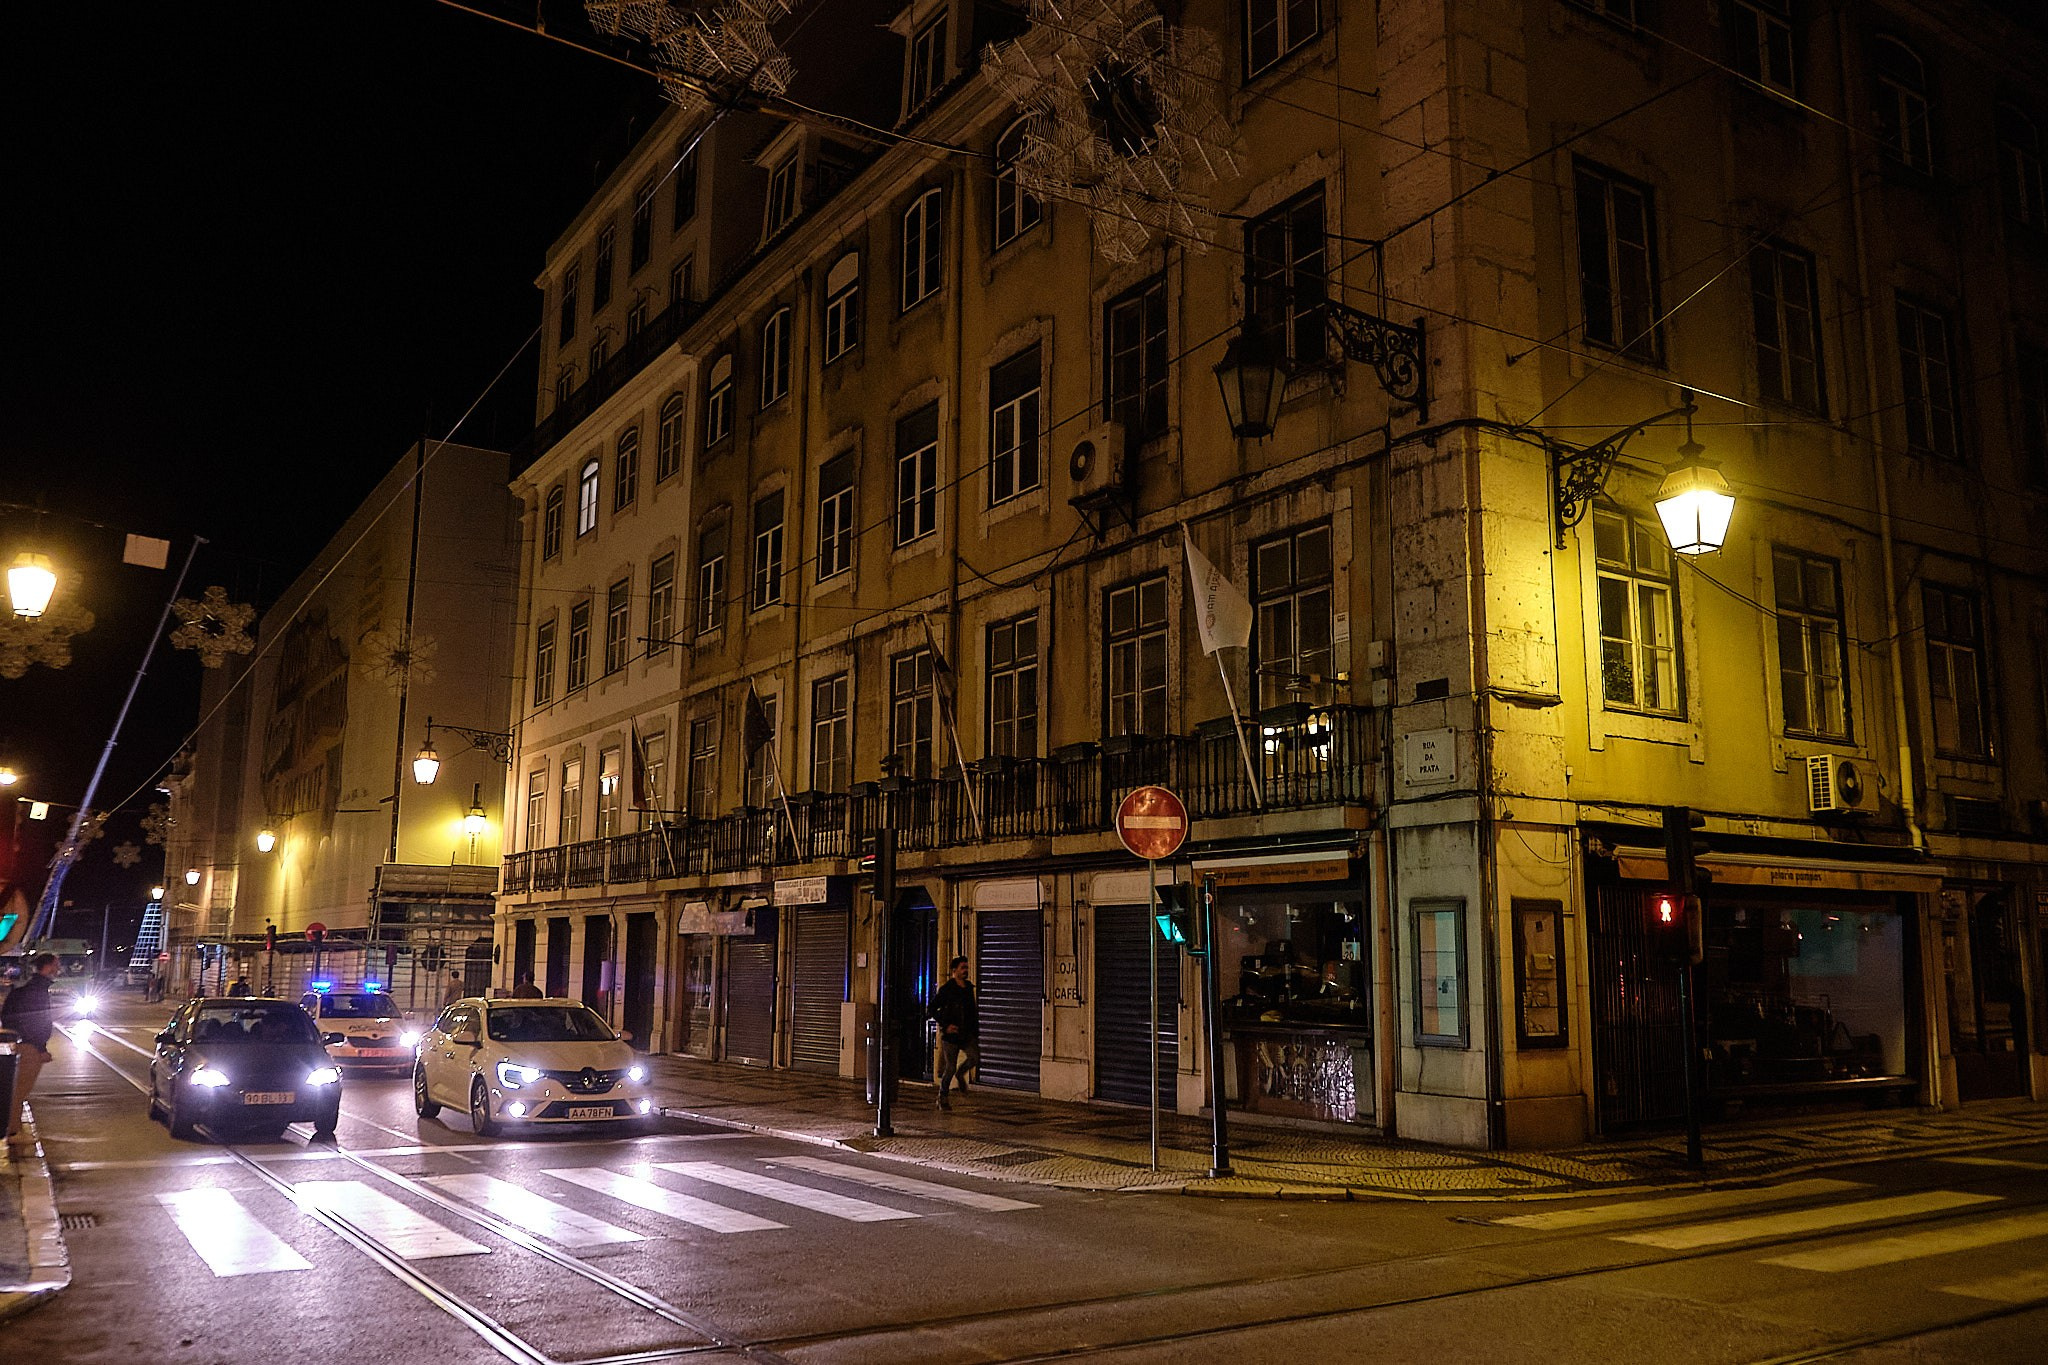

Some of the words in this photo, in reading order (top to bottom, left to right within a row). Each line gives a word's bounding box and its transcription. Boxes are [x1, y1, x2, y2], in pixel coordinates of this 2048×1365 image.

[1422, 741, 1436, 750] RUA
[1424, 753, 1434, 761] DA
[1419, 764, 1440, 773] PRATA
